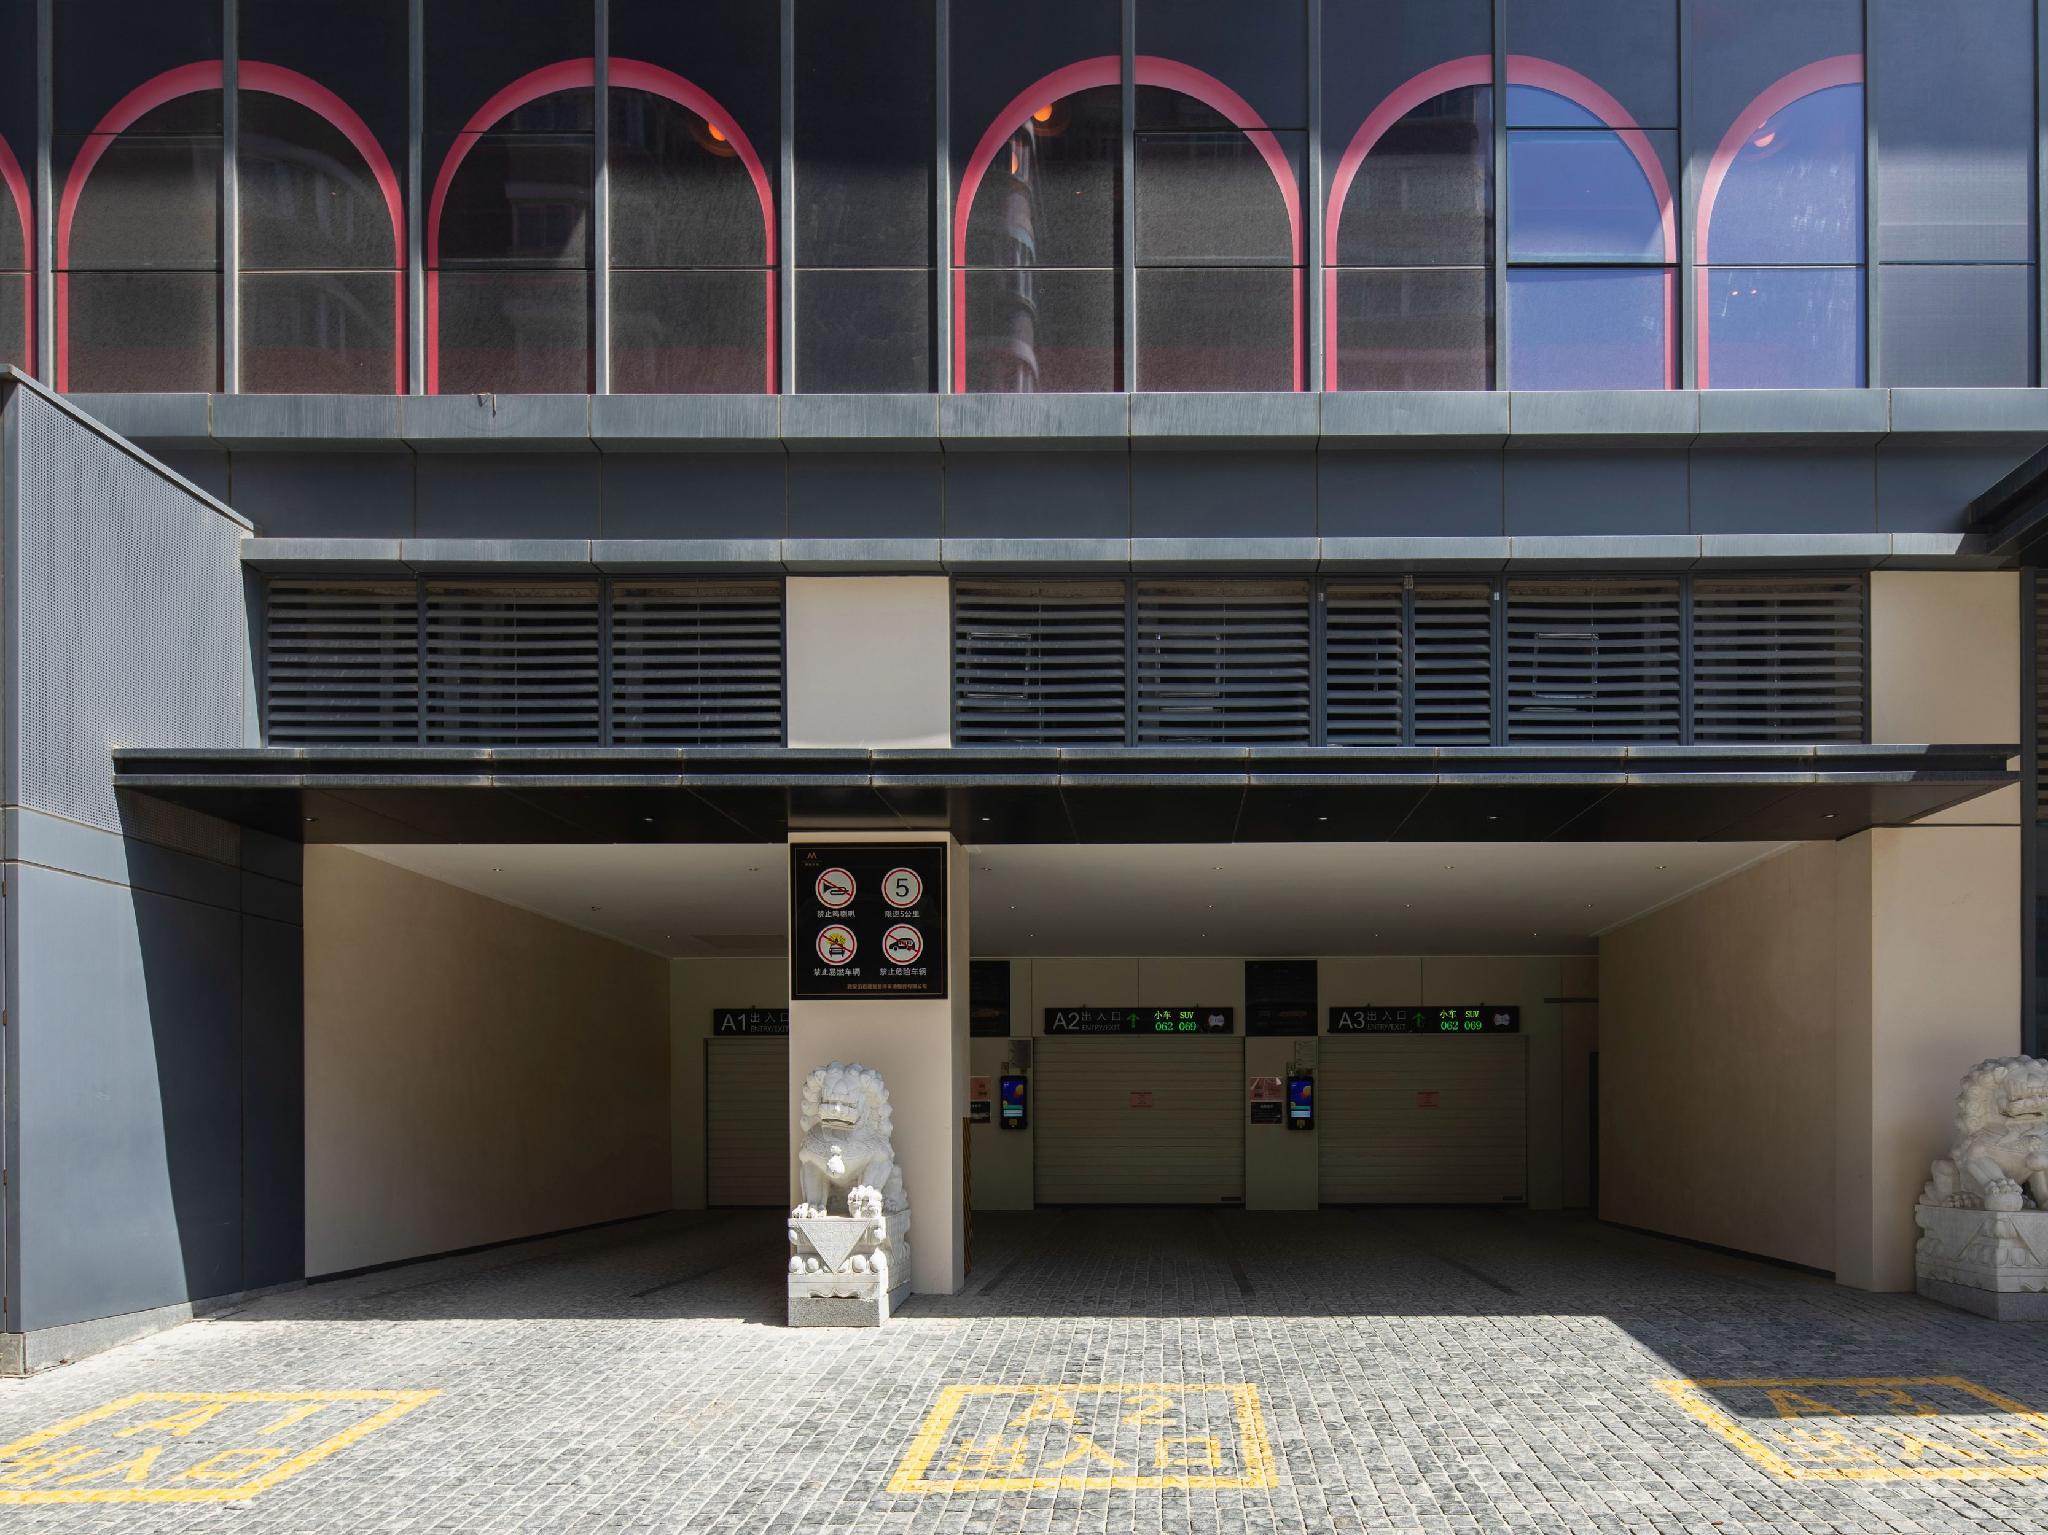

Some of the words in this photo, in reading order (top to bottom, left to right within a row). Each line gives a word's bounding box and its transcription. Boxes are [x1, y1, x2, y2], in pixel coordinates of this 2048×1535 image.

[895, 878, 909, 897] 5
[884, 910, 920, 918] 限速5公里
[750, 1011, 789, 1022] 出入口
[1053, 1011, 1080, 1030] A2
[1081, 1010, 1120, 1021] 出入口
[1154, 1011, 1171, 1019] 小车
[1179, 1011, 1194, 1019] SUV
[1338, 1011, 1365, 1029] A3
[1367, 1010, 1407, 1021] 出入口
[1465, 1010, 1480, 1018] SUV
[720, 1013, 746, 1031] A1
[1155, 1022, 1173, 1031] 062
[1178, 1022, 1197, 1031] 069
[1440, 1021, 1458, 1030] 062
[1464, 1021, 1482, 1030] 069
[1007, 1394, 1175, 1426] A2
[1765, 1388, 1940, 1420] A3
[112, 1402, 330, 1438] A1
[946, 1434, 1222, 1471] 出入口
